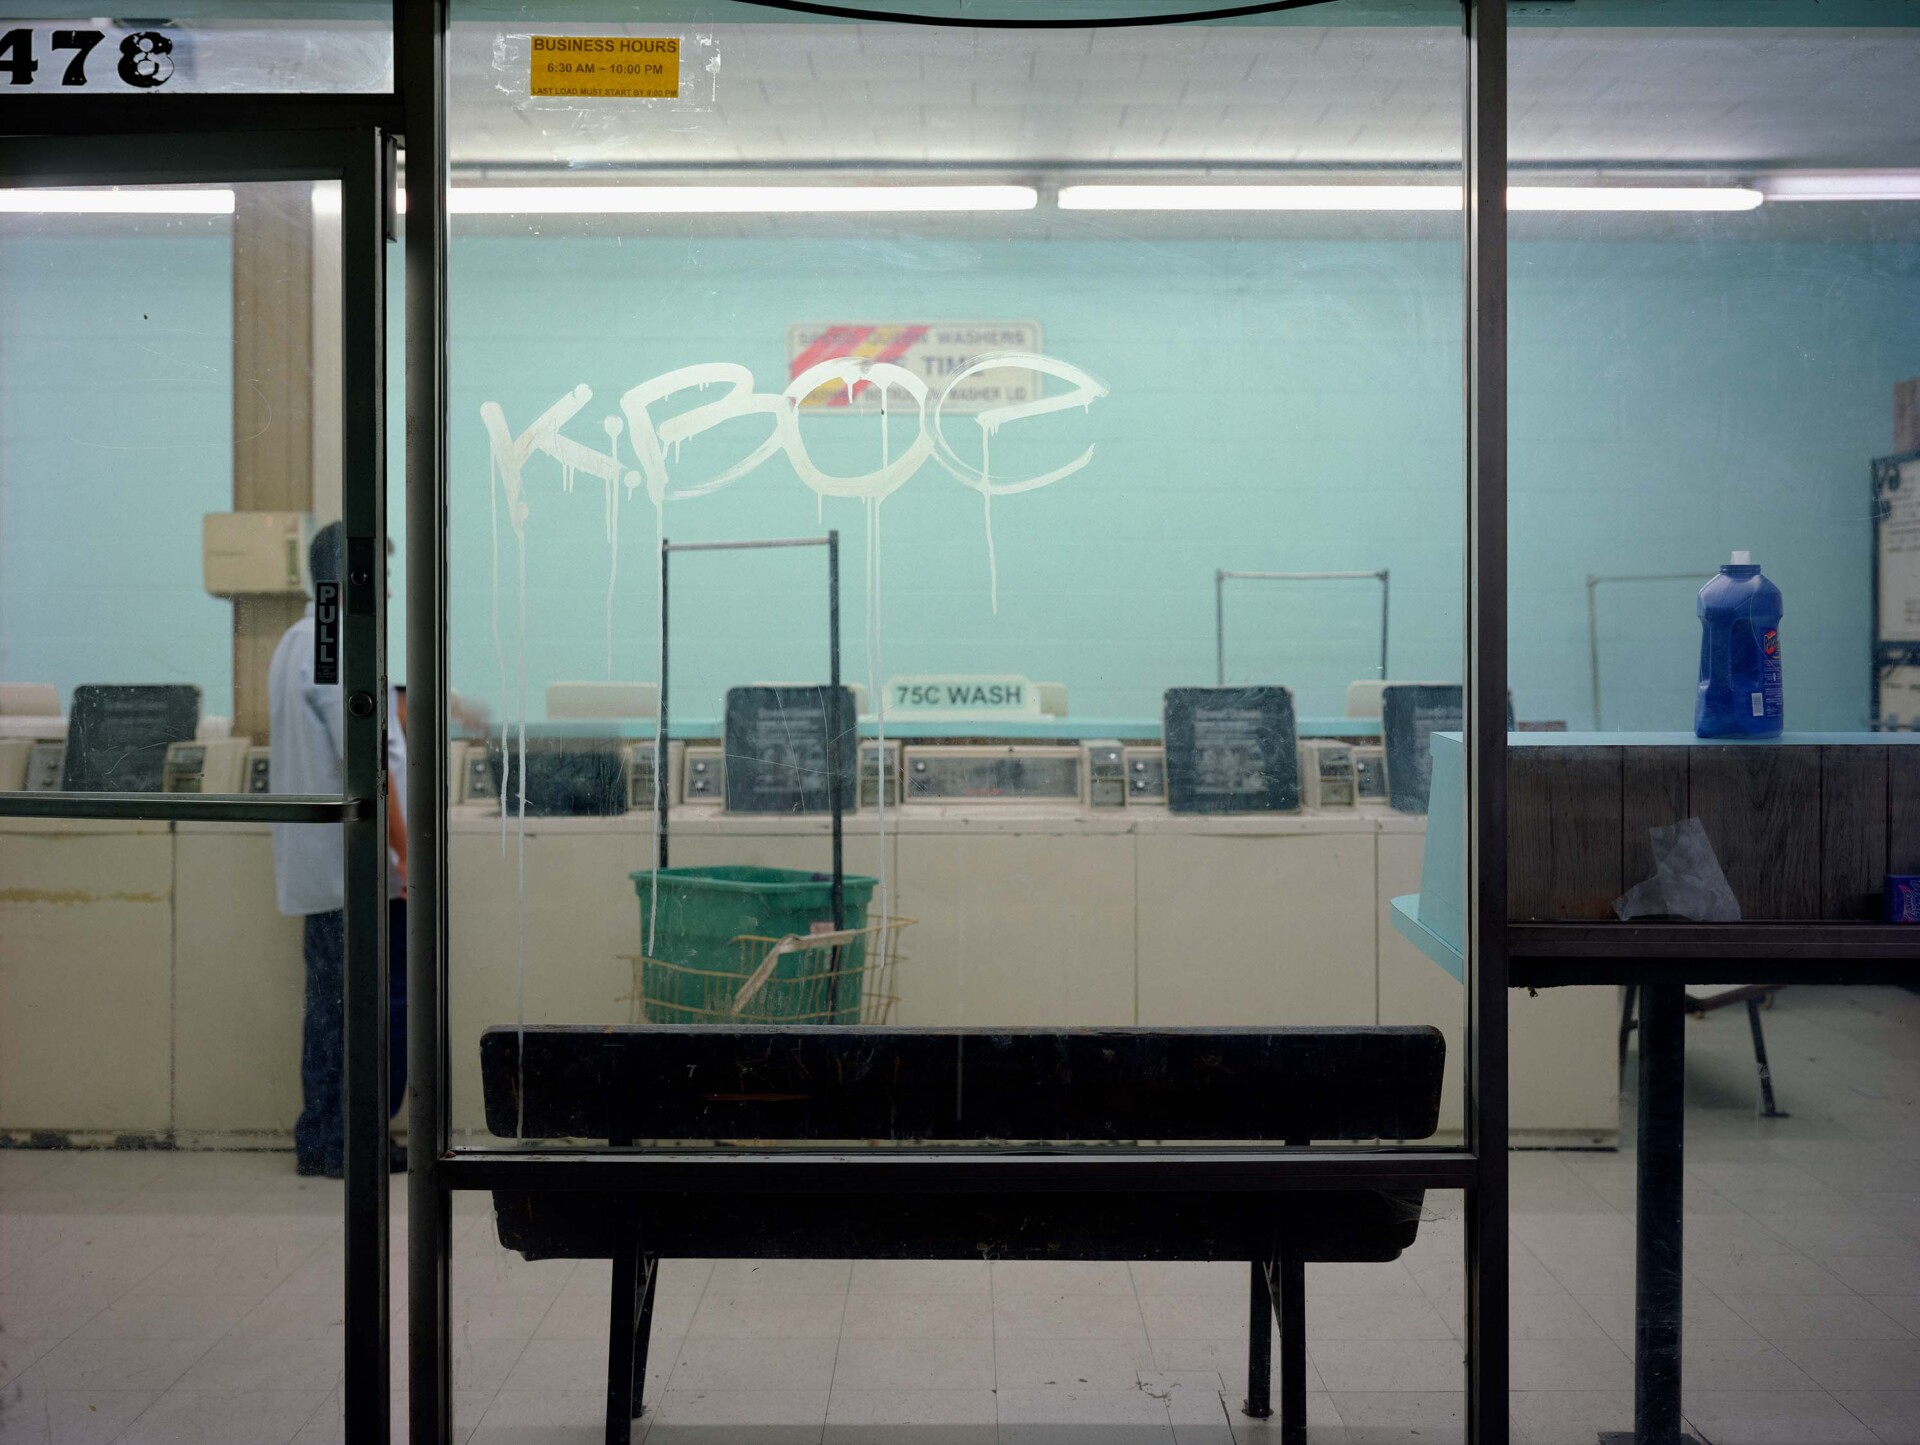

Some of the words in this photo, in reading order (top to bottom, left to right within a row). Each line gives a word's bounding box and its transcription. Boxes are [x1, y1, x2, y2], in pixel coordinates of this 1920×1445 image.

[534, 38, 615, 52] BUSINESS
[620, 40, 677, 53] HOURS
[0, 29, 175, 88] 478
[547, 62, 572, 73] 6:30
[575, 63, 595, 73] AM
[610, 64, 641, 75] 10:00
[644, 65, 663, 75] PM
[937, 329, 1026, 345] WASHERS
[319, 585, 336, 663] PULL
[897, 685, 941, 705] 75C
[946, 685, 1022, 705] WASH
